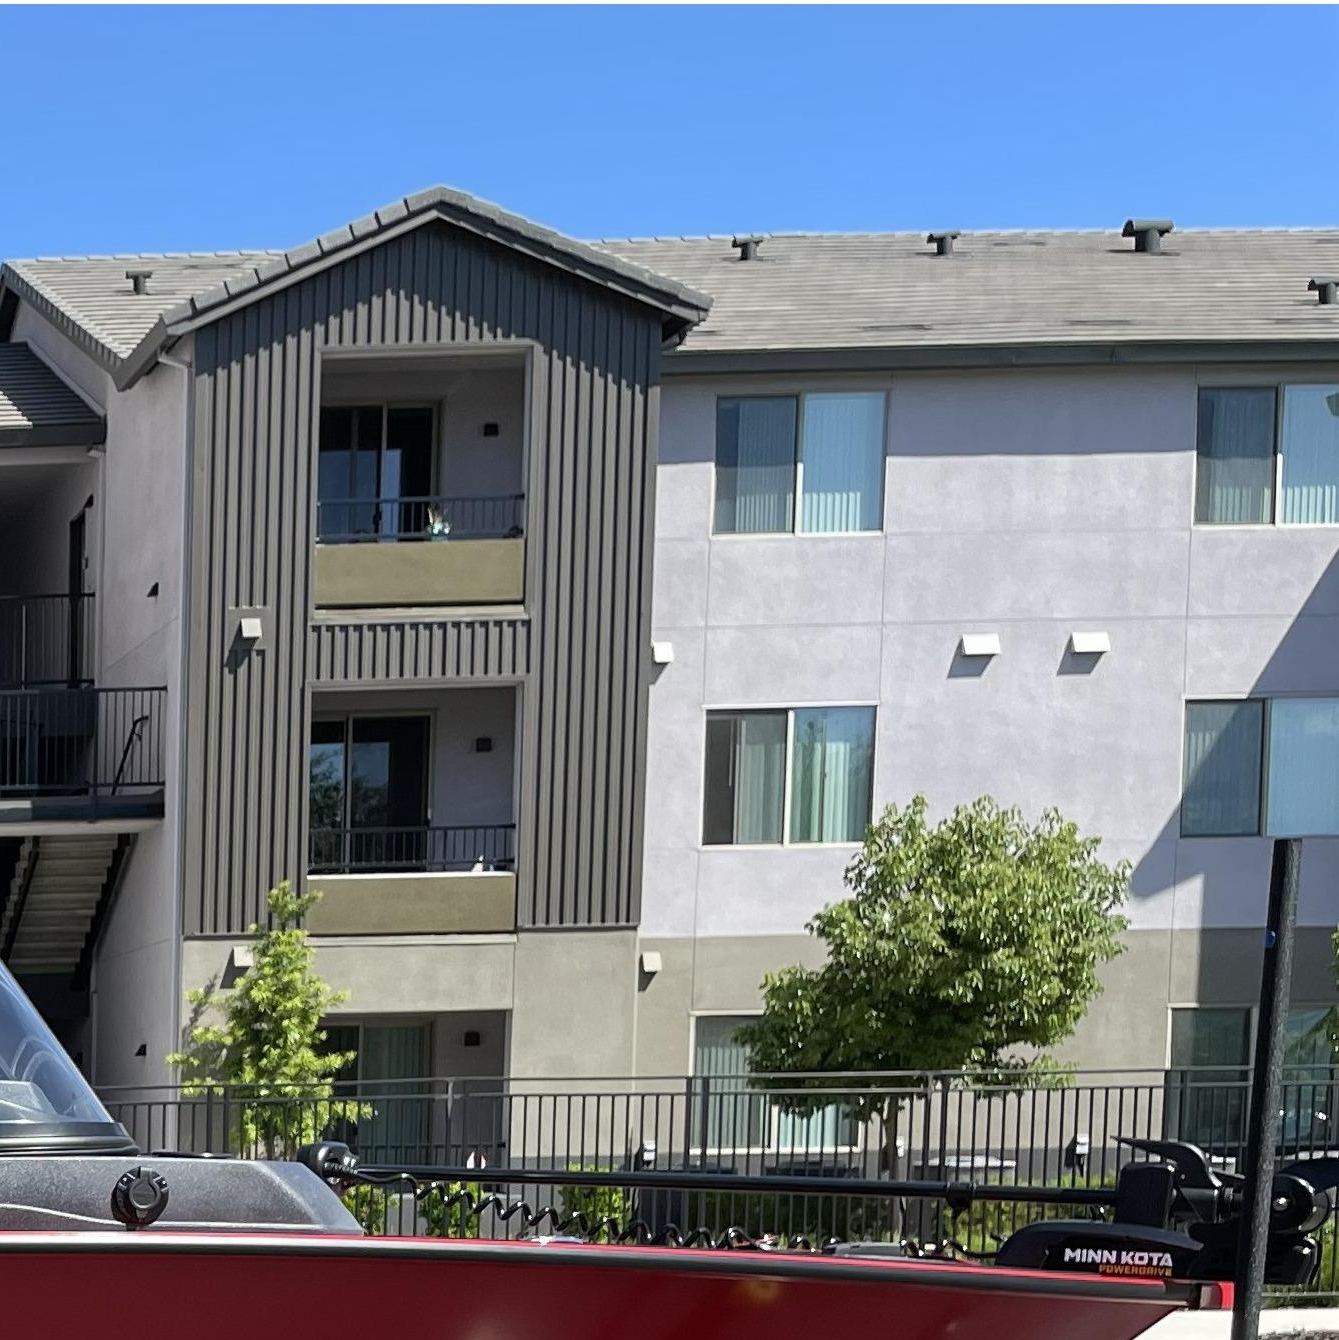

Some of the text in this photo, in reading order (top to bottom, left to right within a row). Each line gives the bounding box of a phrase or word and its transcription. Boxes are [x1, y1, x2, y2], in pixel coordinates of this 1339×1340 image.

[1064, 1248, 1173, 1267] MINN KOTA
[1099, 1264, 1172, 1277] POWERDRIVE
